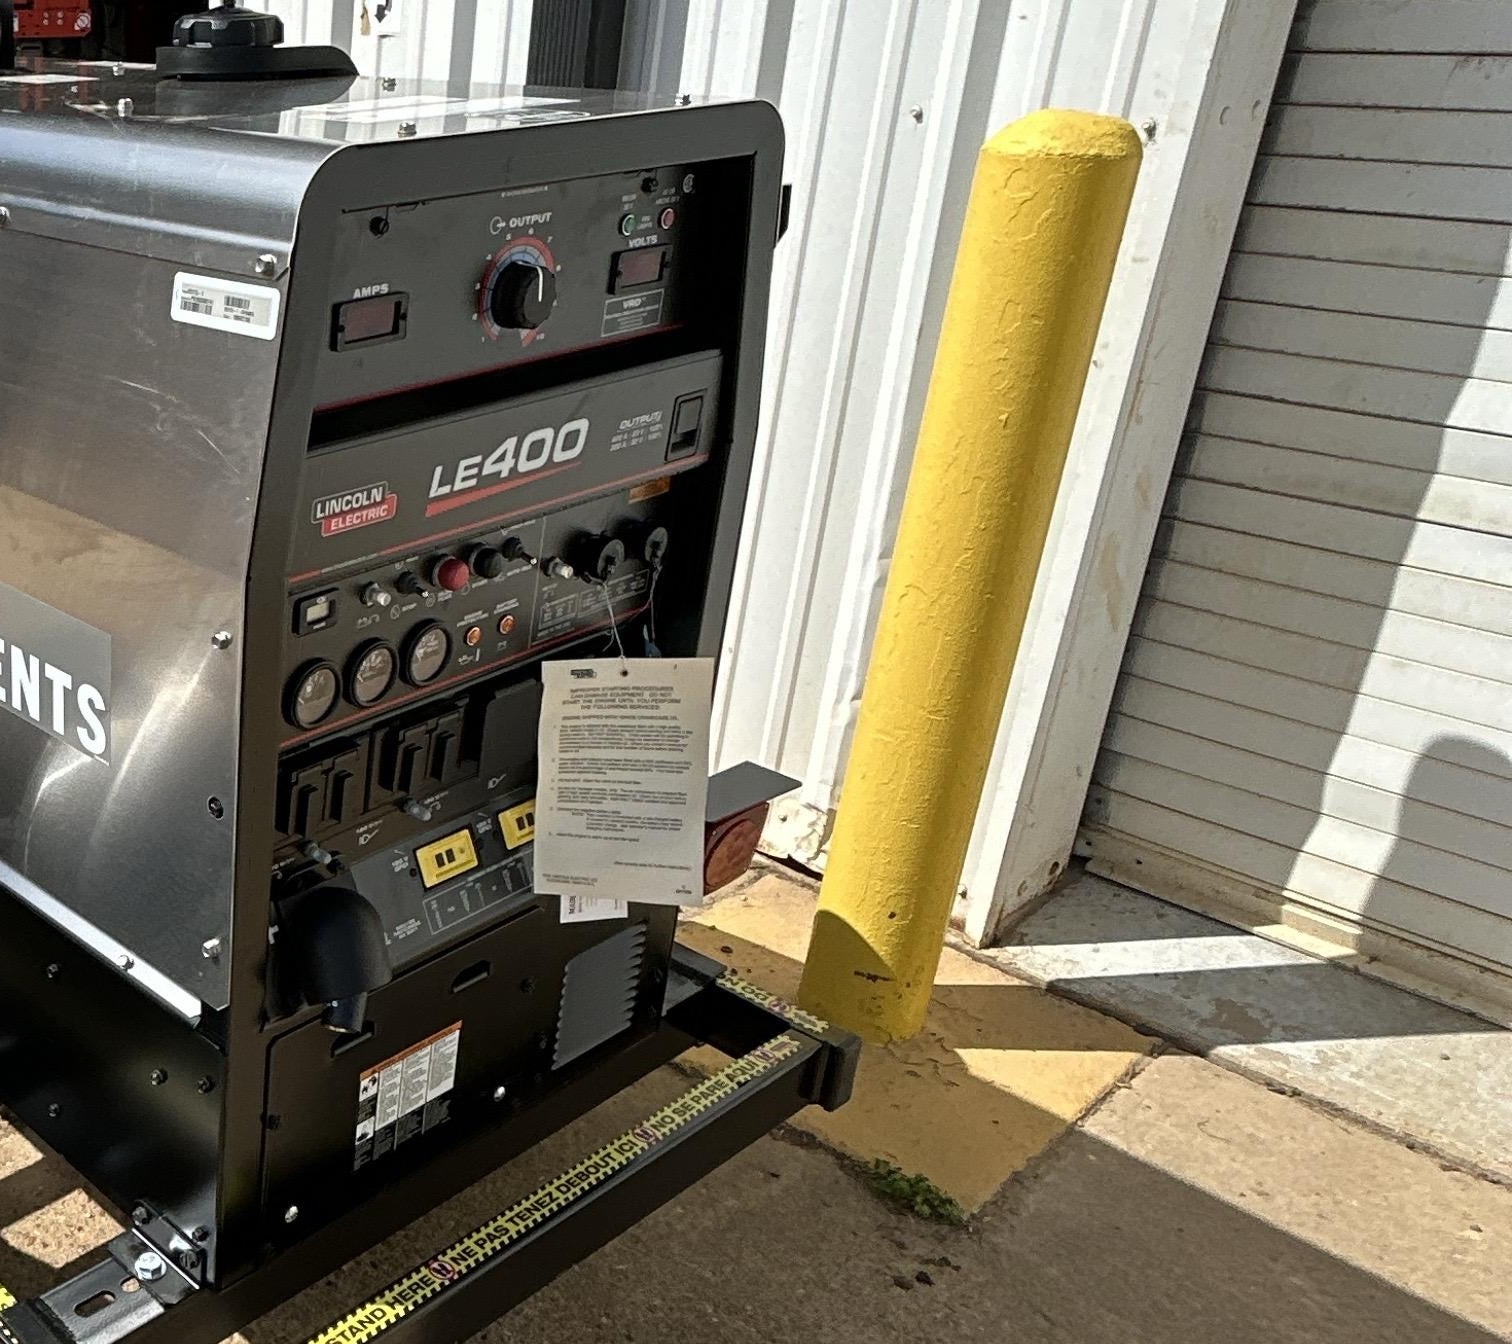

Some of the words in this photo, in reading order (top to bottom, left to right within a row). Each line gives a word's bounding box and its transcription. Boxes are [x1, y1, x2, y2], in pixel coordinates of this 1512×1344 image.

[509, 211, 552, 228] OUTPUT
[628, 235, 658, 247] VOLTS
[352, 283, 389, 299] AMPS
[428, 417, 590, 499] LE400
[315, 487, 383, 520] LINCOLN
[330, 505, 389, 531] ELECTRIC
[386, 1276, 435, 1309] HERE
[451, 1247, 478, 1266] NE
[476, 1224, 508, 1249] PAS
[506, 1192, 558, 1227] TENEZ
[554, 1152, 615, 1195] DEBOUT
[615, 1139, 638, 1158] ICI
[651, 1113, 676, 1133] NO
[671, 1099, 693, 1118] SE
[690, 1078, 729, 1105] PARE
